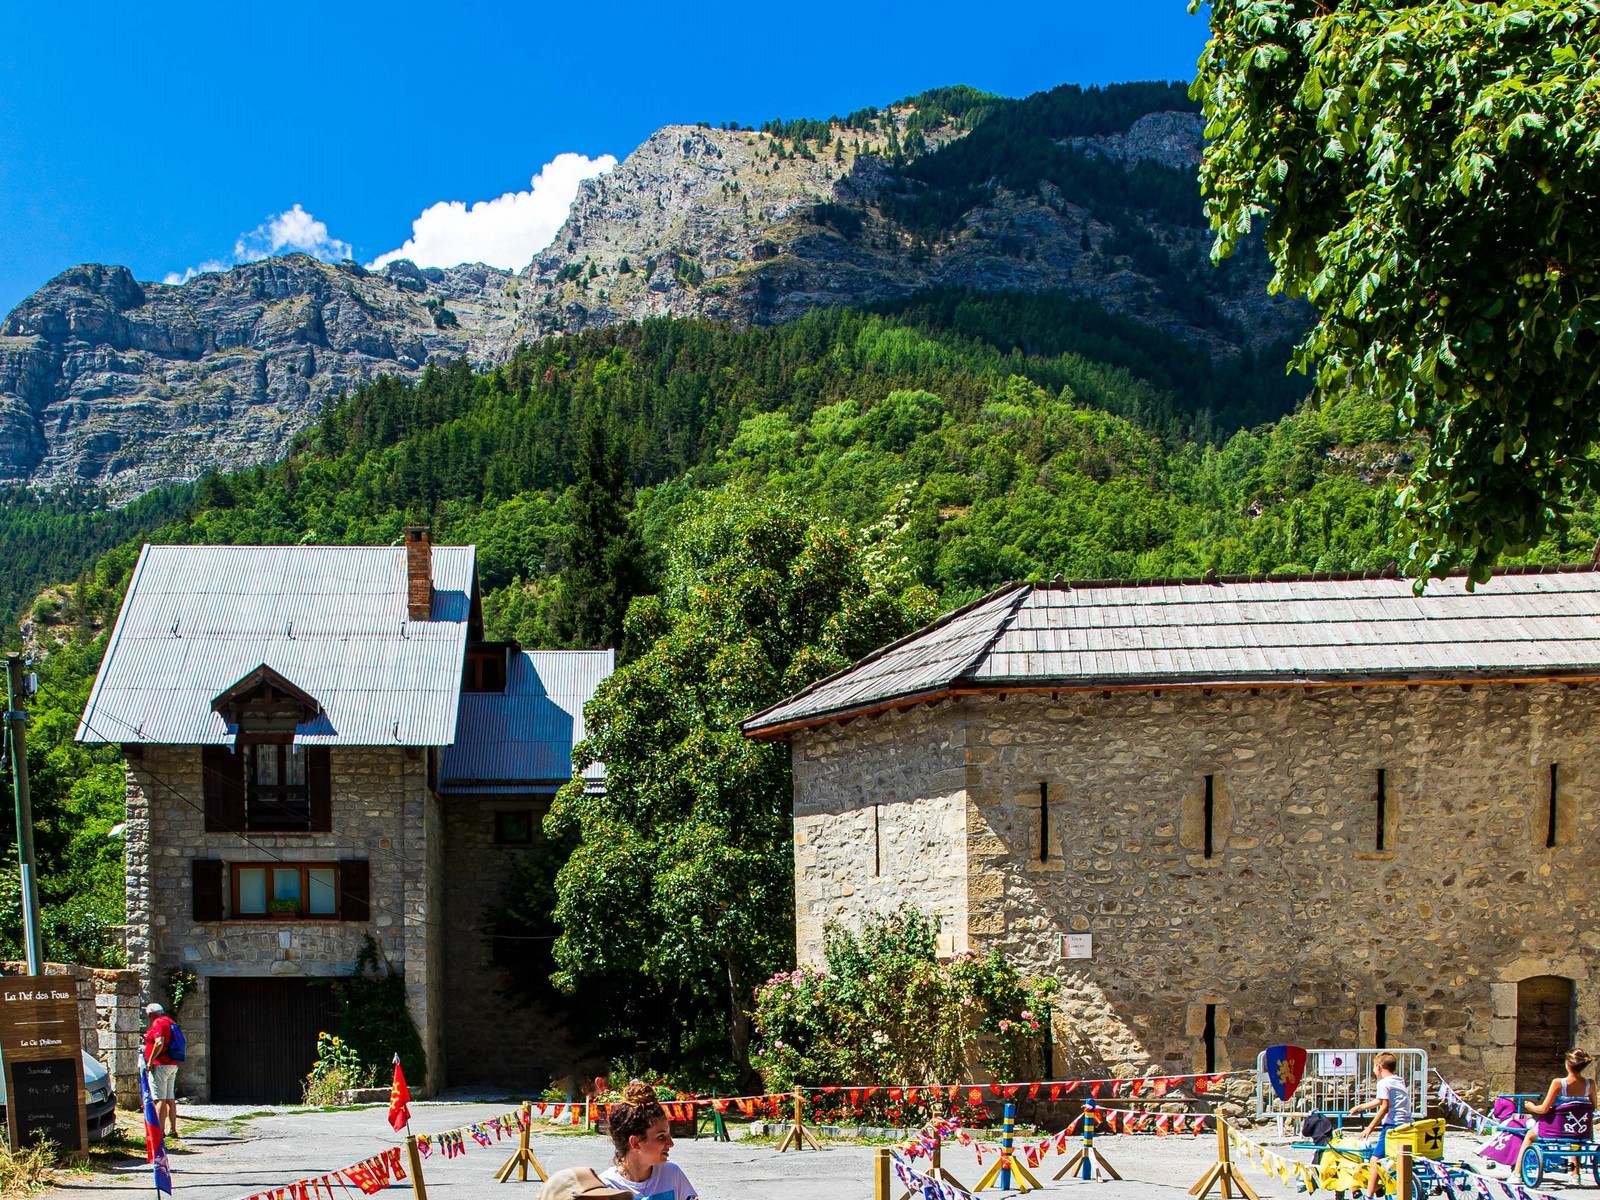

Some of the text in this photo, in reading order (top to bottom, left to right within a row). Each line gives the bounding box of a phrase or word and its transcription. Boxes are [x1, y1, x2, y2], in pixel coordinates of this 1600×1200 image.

[4, 990, 70, 1001] La Nef des Fous
